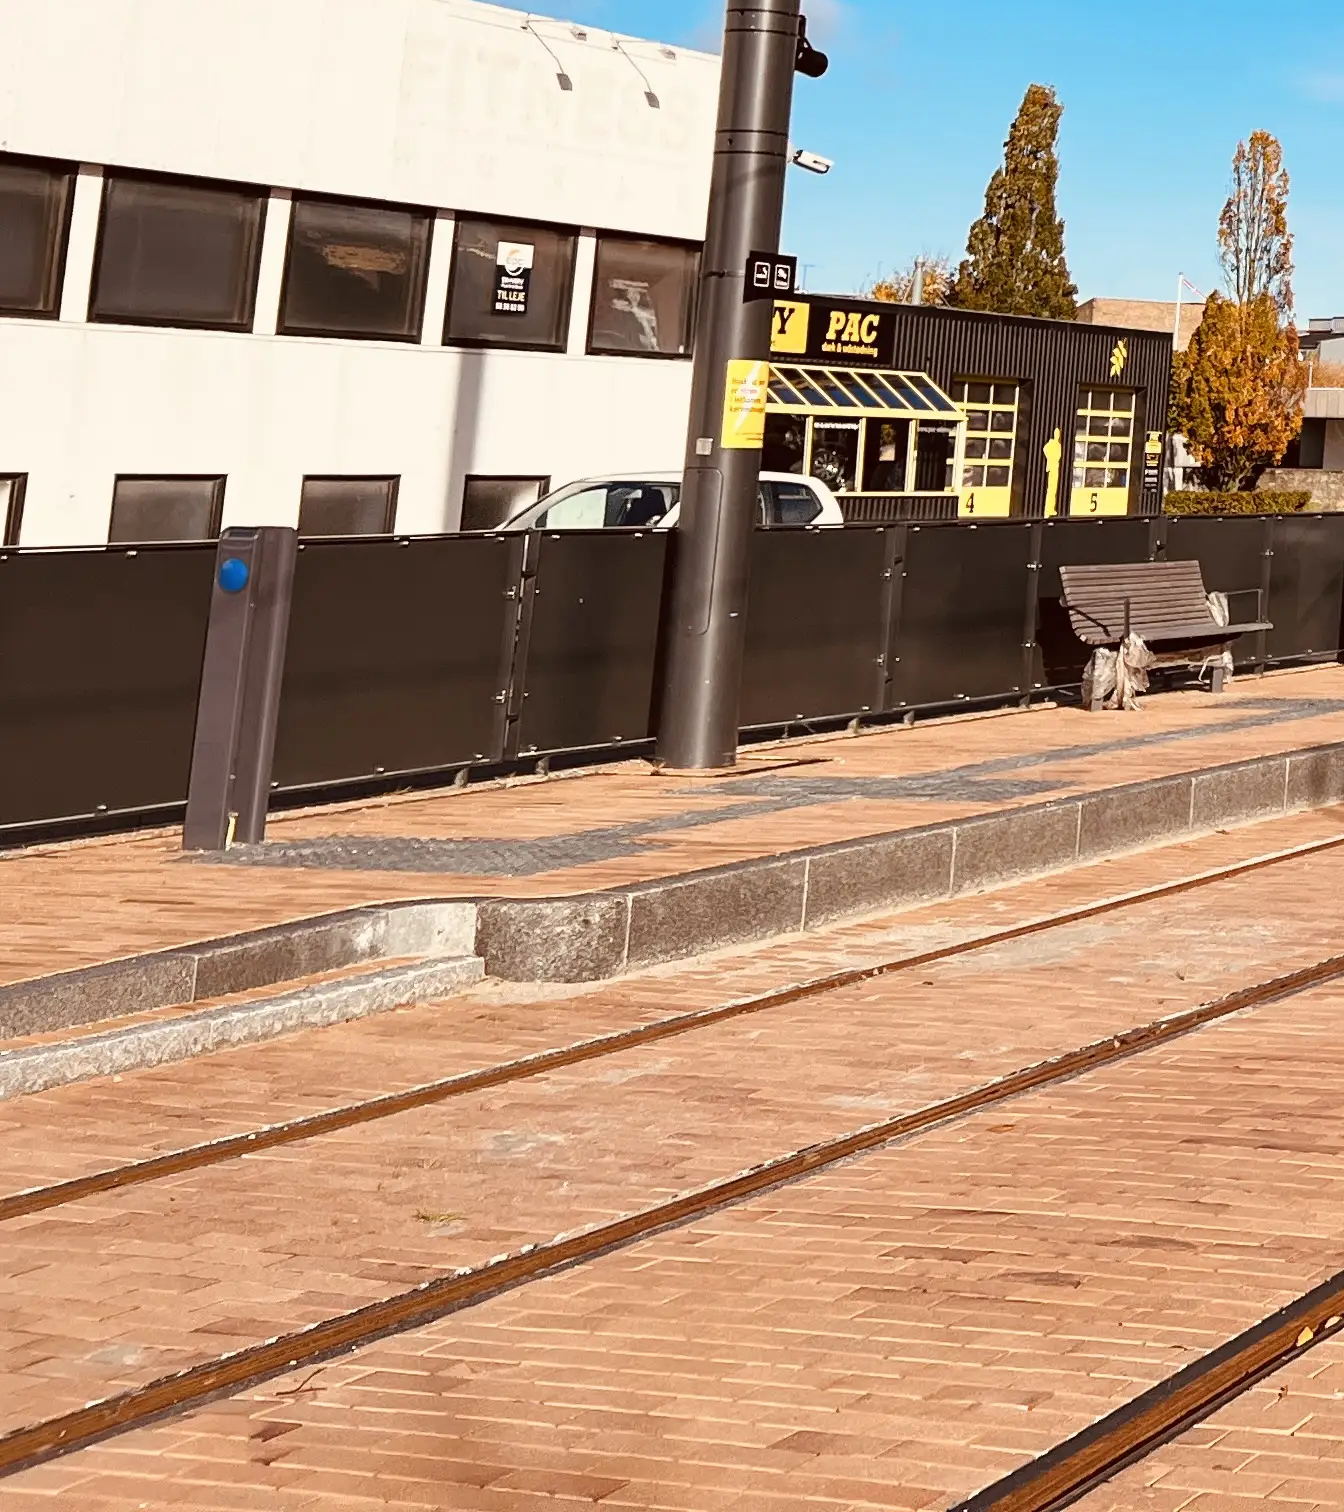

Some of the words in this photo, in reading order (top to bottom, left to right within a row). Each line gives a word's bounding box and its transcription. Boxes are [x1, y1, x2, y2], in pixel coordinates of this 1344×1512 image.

[826, 311, 880, 344] PAC
[966, 492, 975, 513] 4
[1090, 493, 1098, 513] 5
